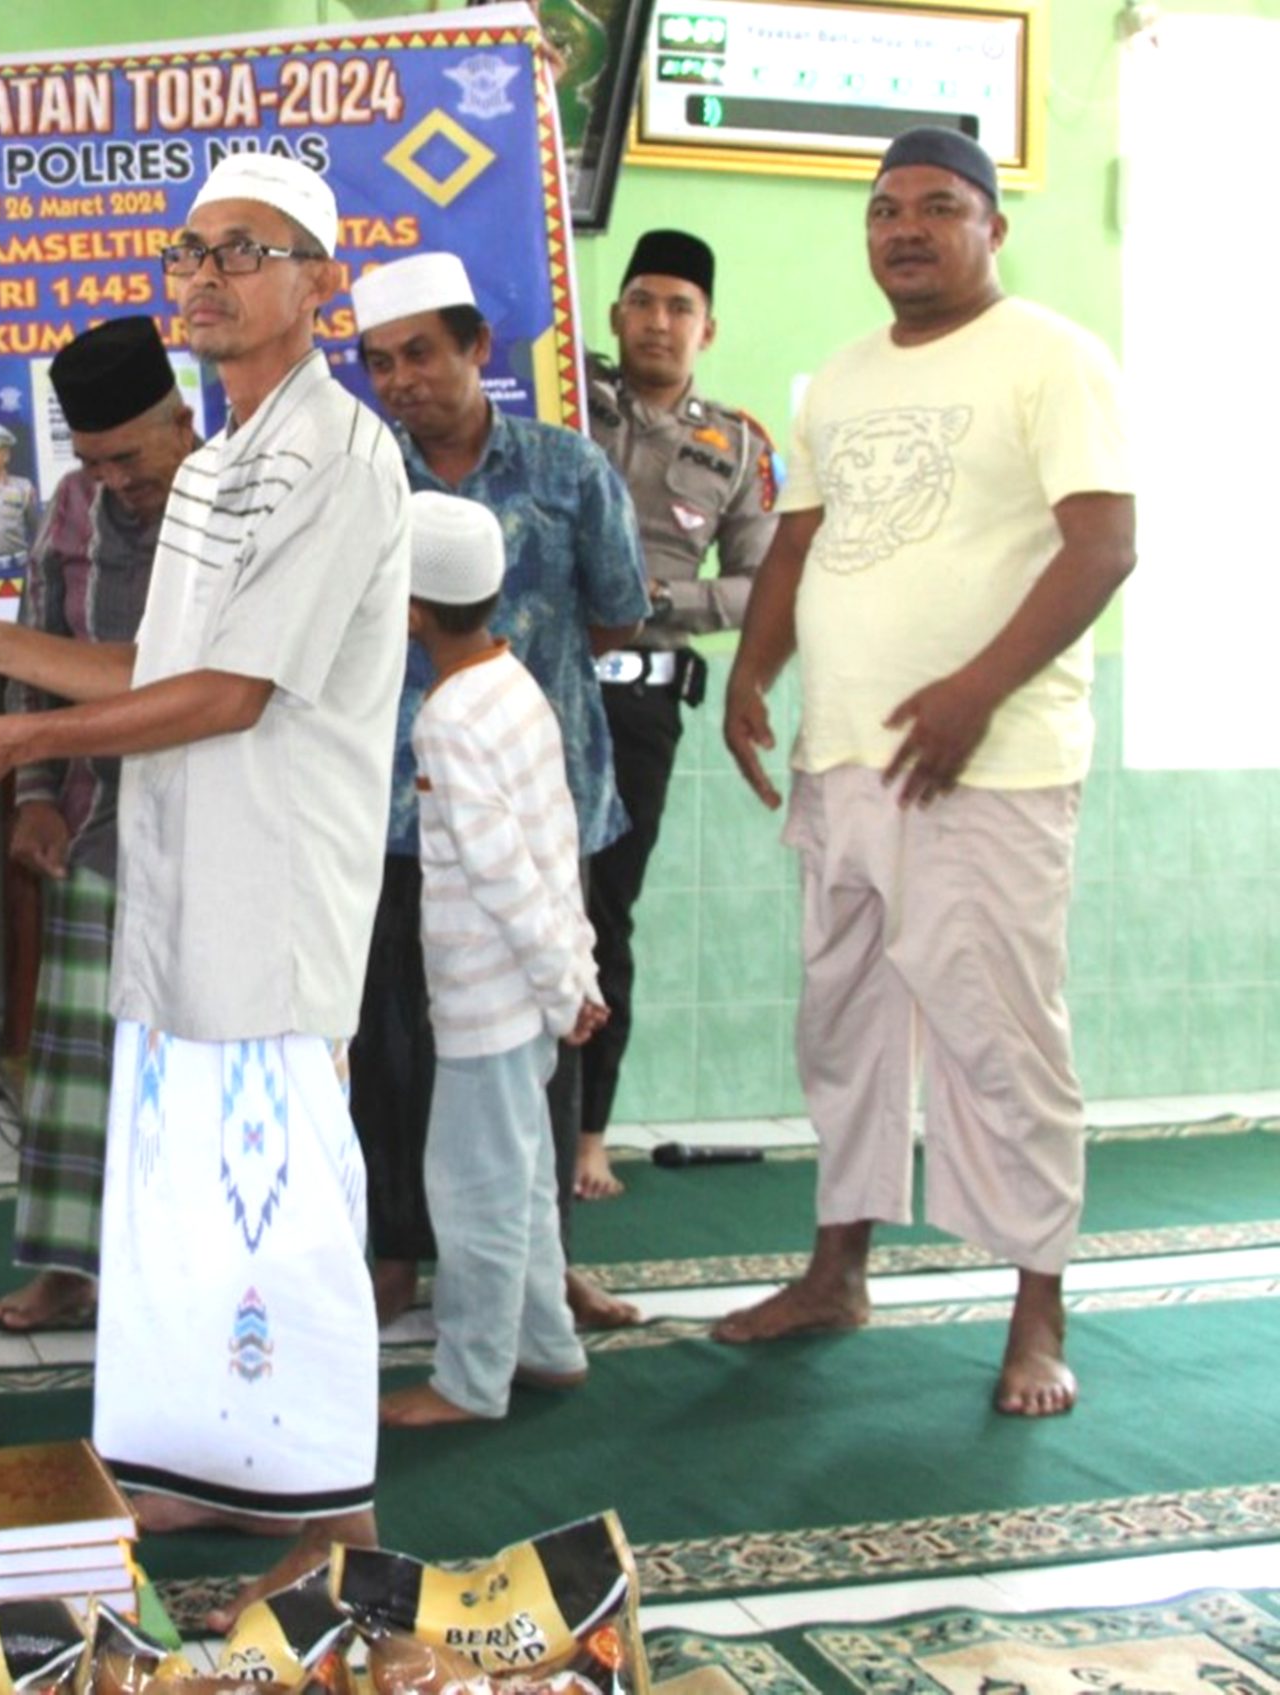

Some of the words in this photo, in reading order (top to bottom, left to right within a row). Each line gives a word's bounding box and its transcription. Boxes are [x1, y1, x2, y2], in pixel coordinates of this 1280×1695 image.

[123, 57, 404, 133] TOBA-2024
[5, 141, 191, 186] POLRES
[5, 197, 33, 220] 26
[40, 193, 104, 218] Maret
[111, 191, 166, 215] 2024
[51, 273, 151, 307] 1445
[444, 1611, 538, 1646] BERAS
